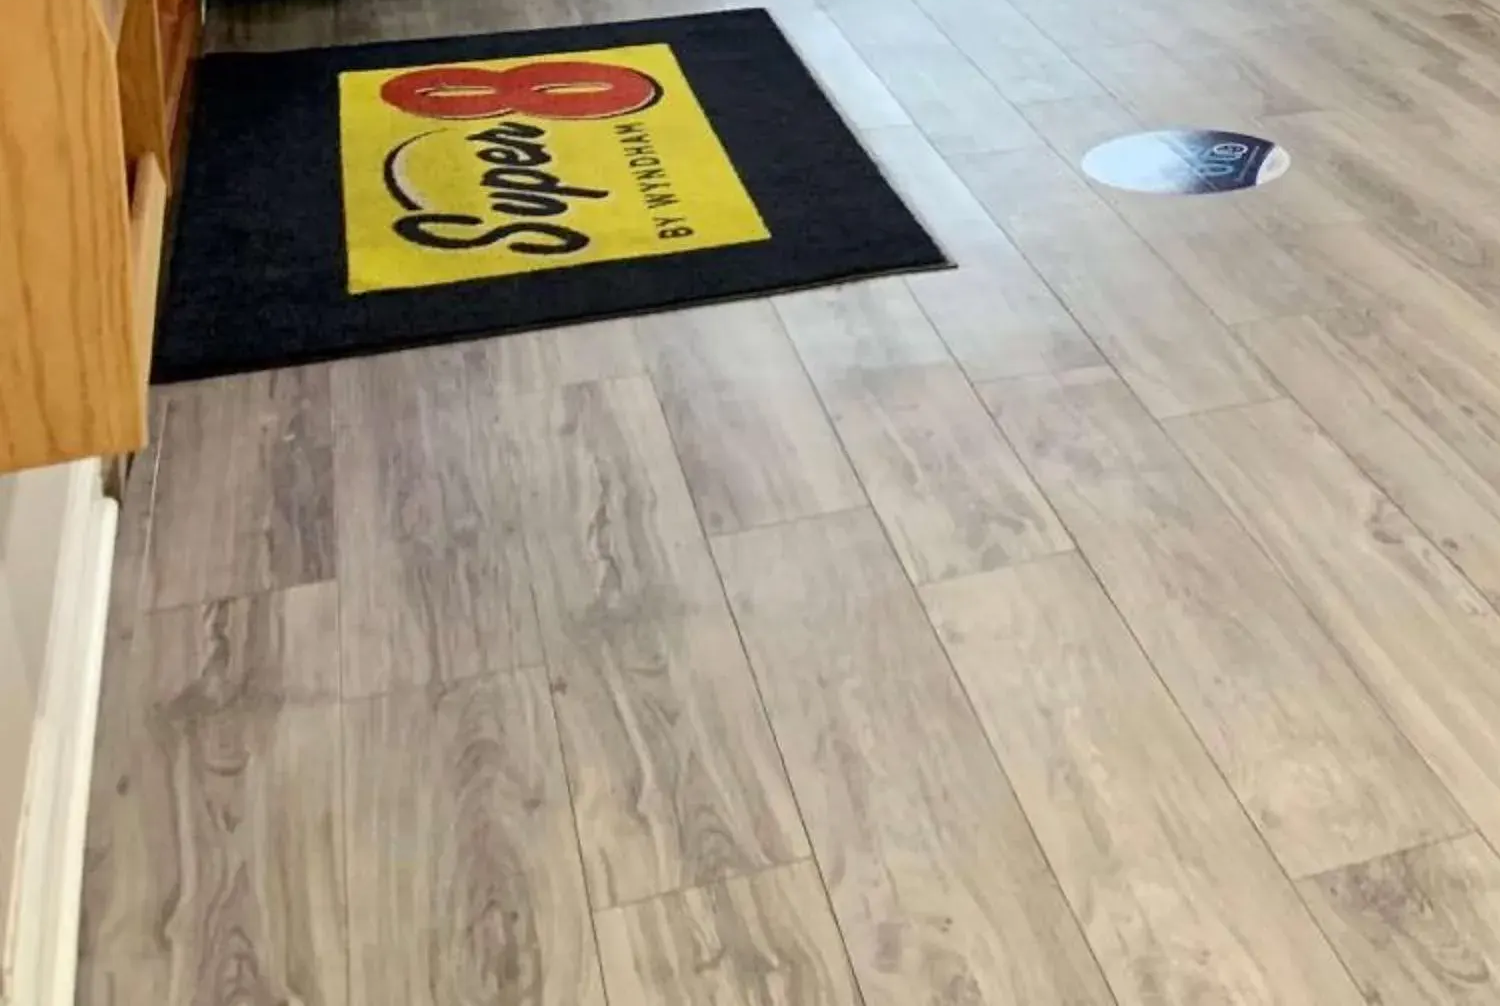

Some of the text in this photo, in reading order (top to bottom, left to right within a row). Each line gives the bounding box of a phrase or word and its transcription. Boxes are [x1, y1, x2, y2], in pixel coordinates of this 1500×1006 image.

[380, 61, 664, 254] Super 8
[613, 121, 694, 240] BY WYNDHAM
